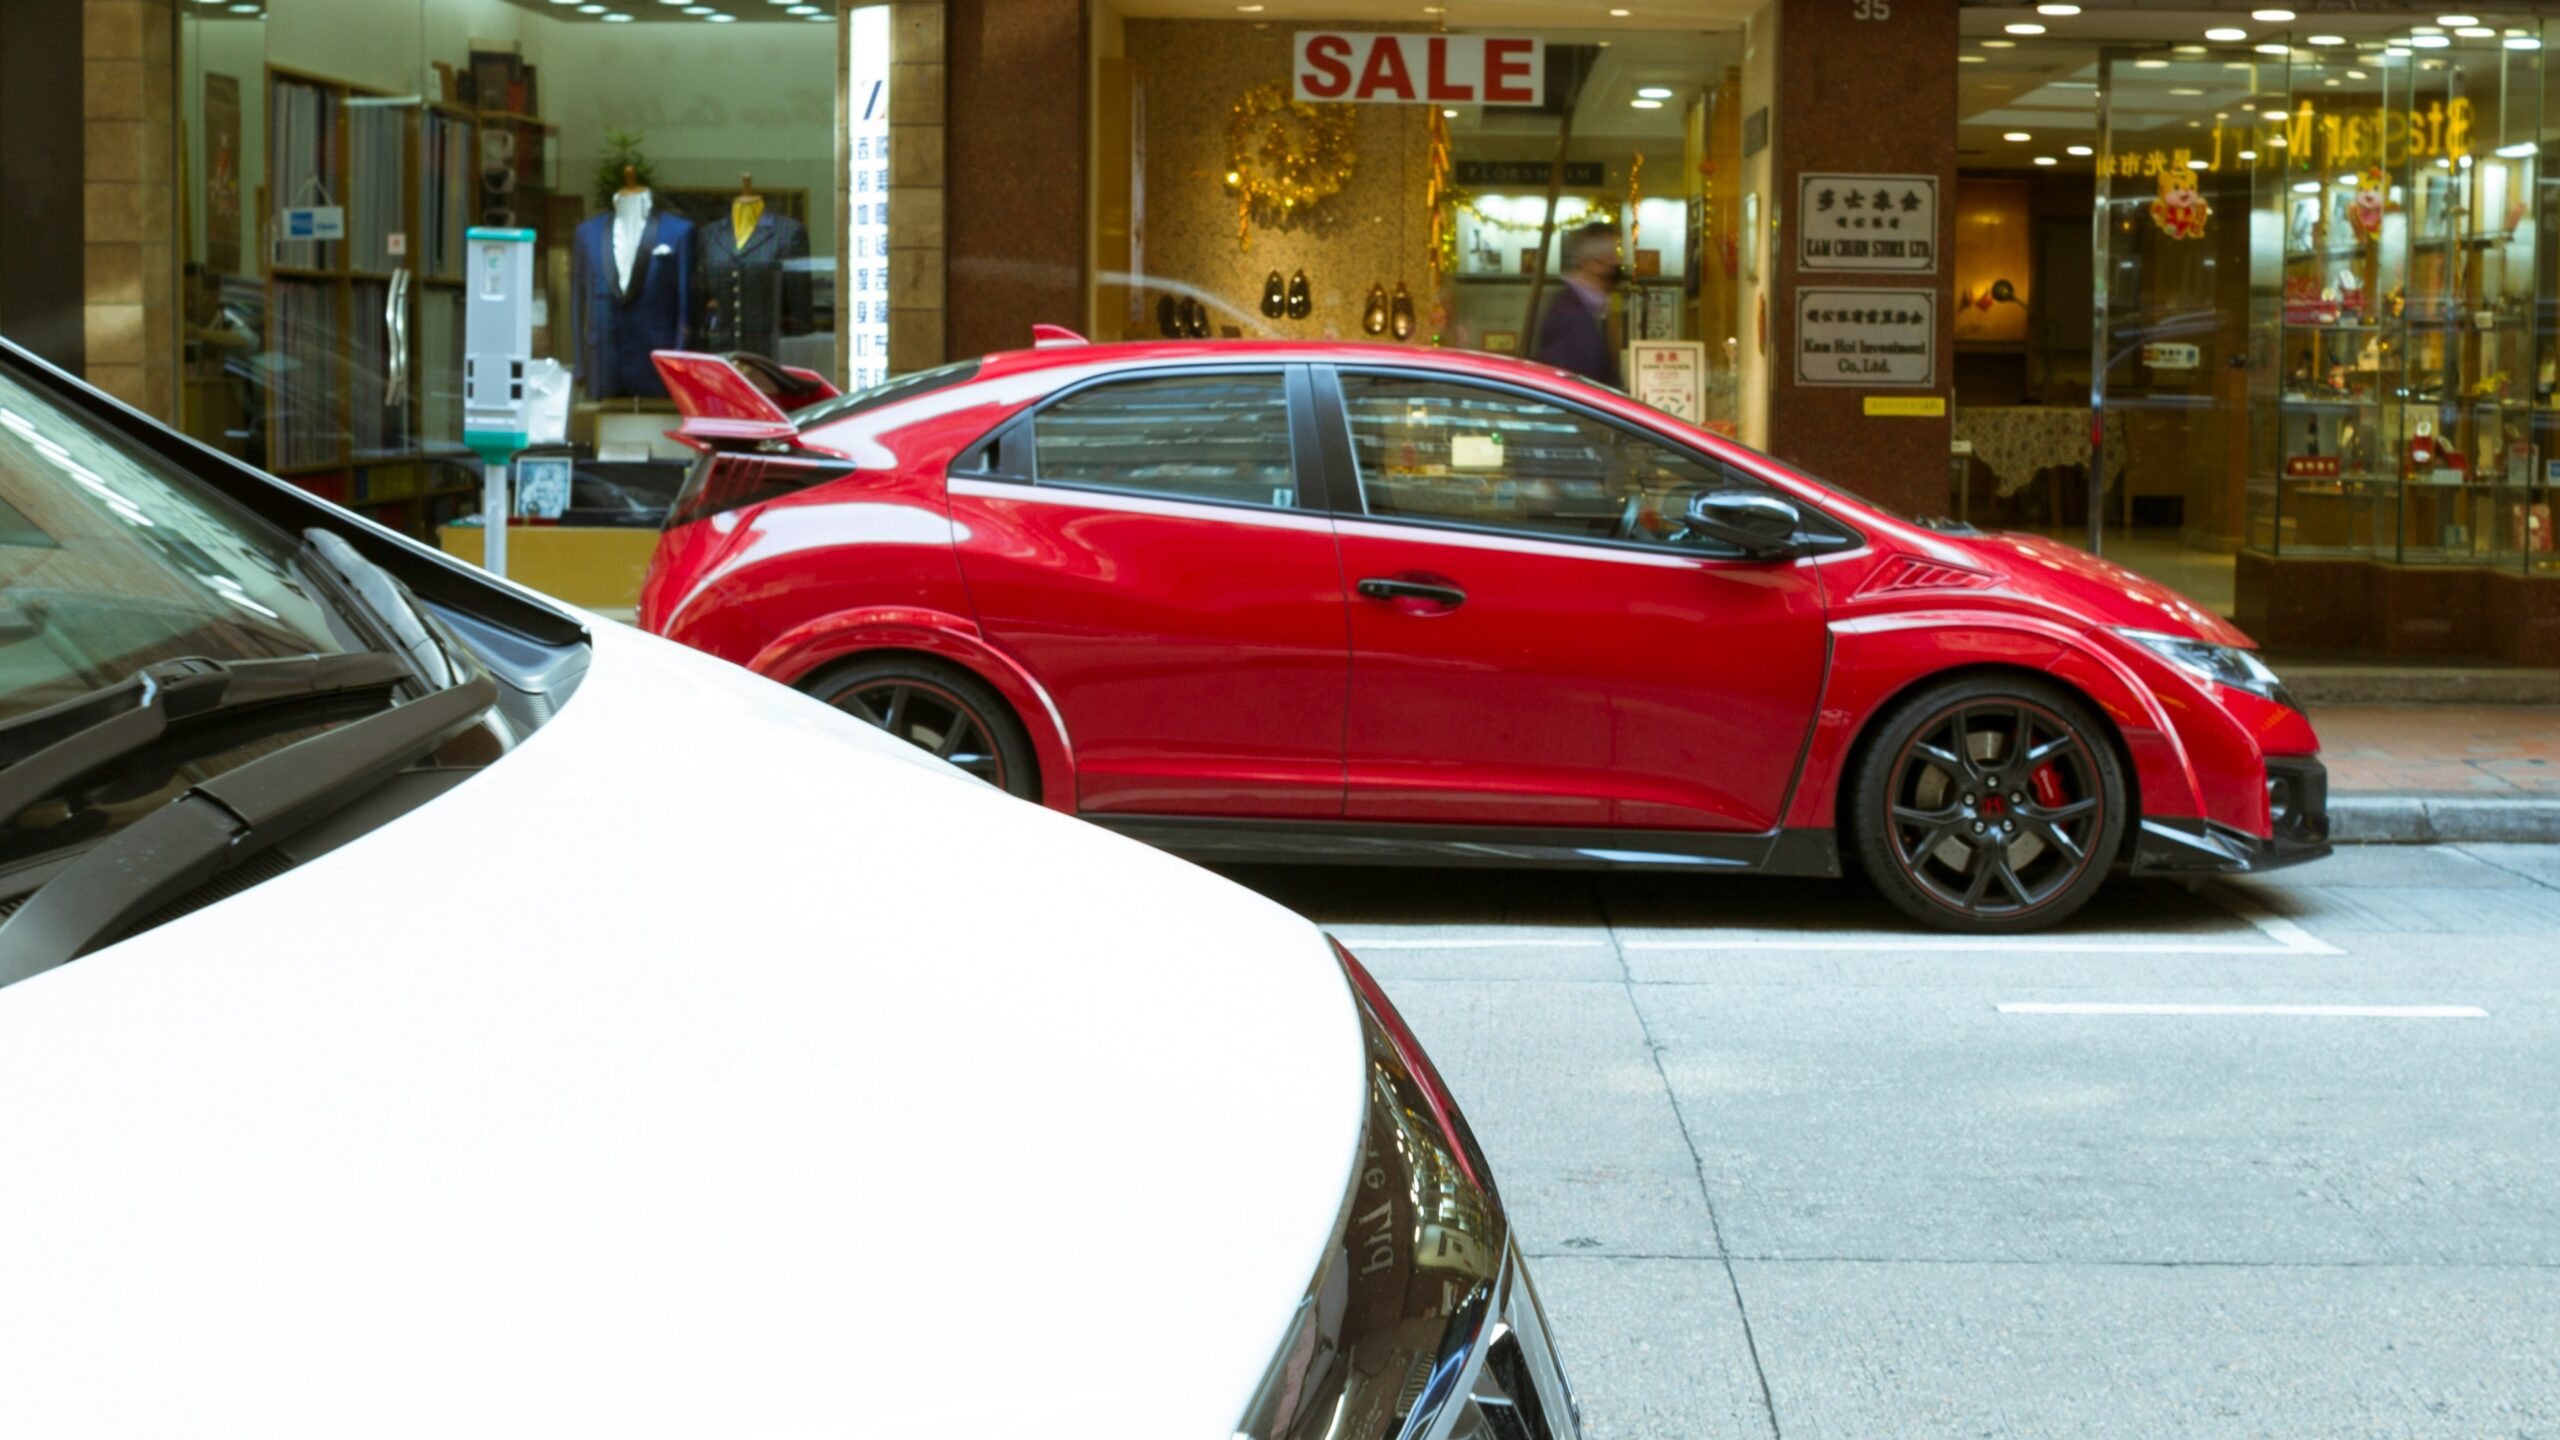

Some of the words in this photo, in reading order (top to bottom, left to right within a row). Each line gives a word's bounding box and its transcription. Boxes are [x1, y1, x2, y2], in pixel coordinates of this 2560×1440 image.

[1853, 0, 1890, 20] 35
[1301, 35, 1533, 102] SALE
[1467, 165, 1592, 180] FLORSHIM
[1806, 239, 1831, 257] KAM
[1860, 340, 1926, 355] Investment
